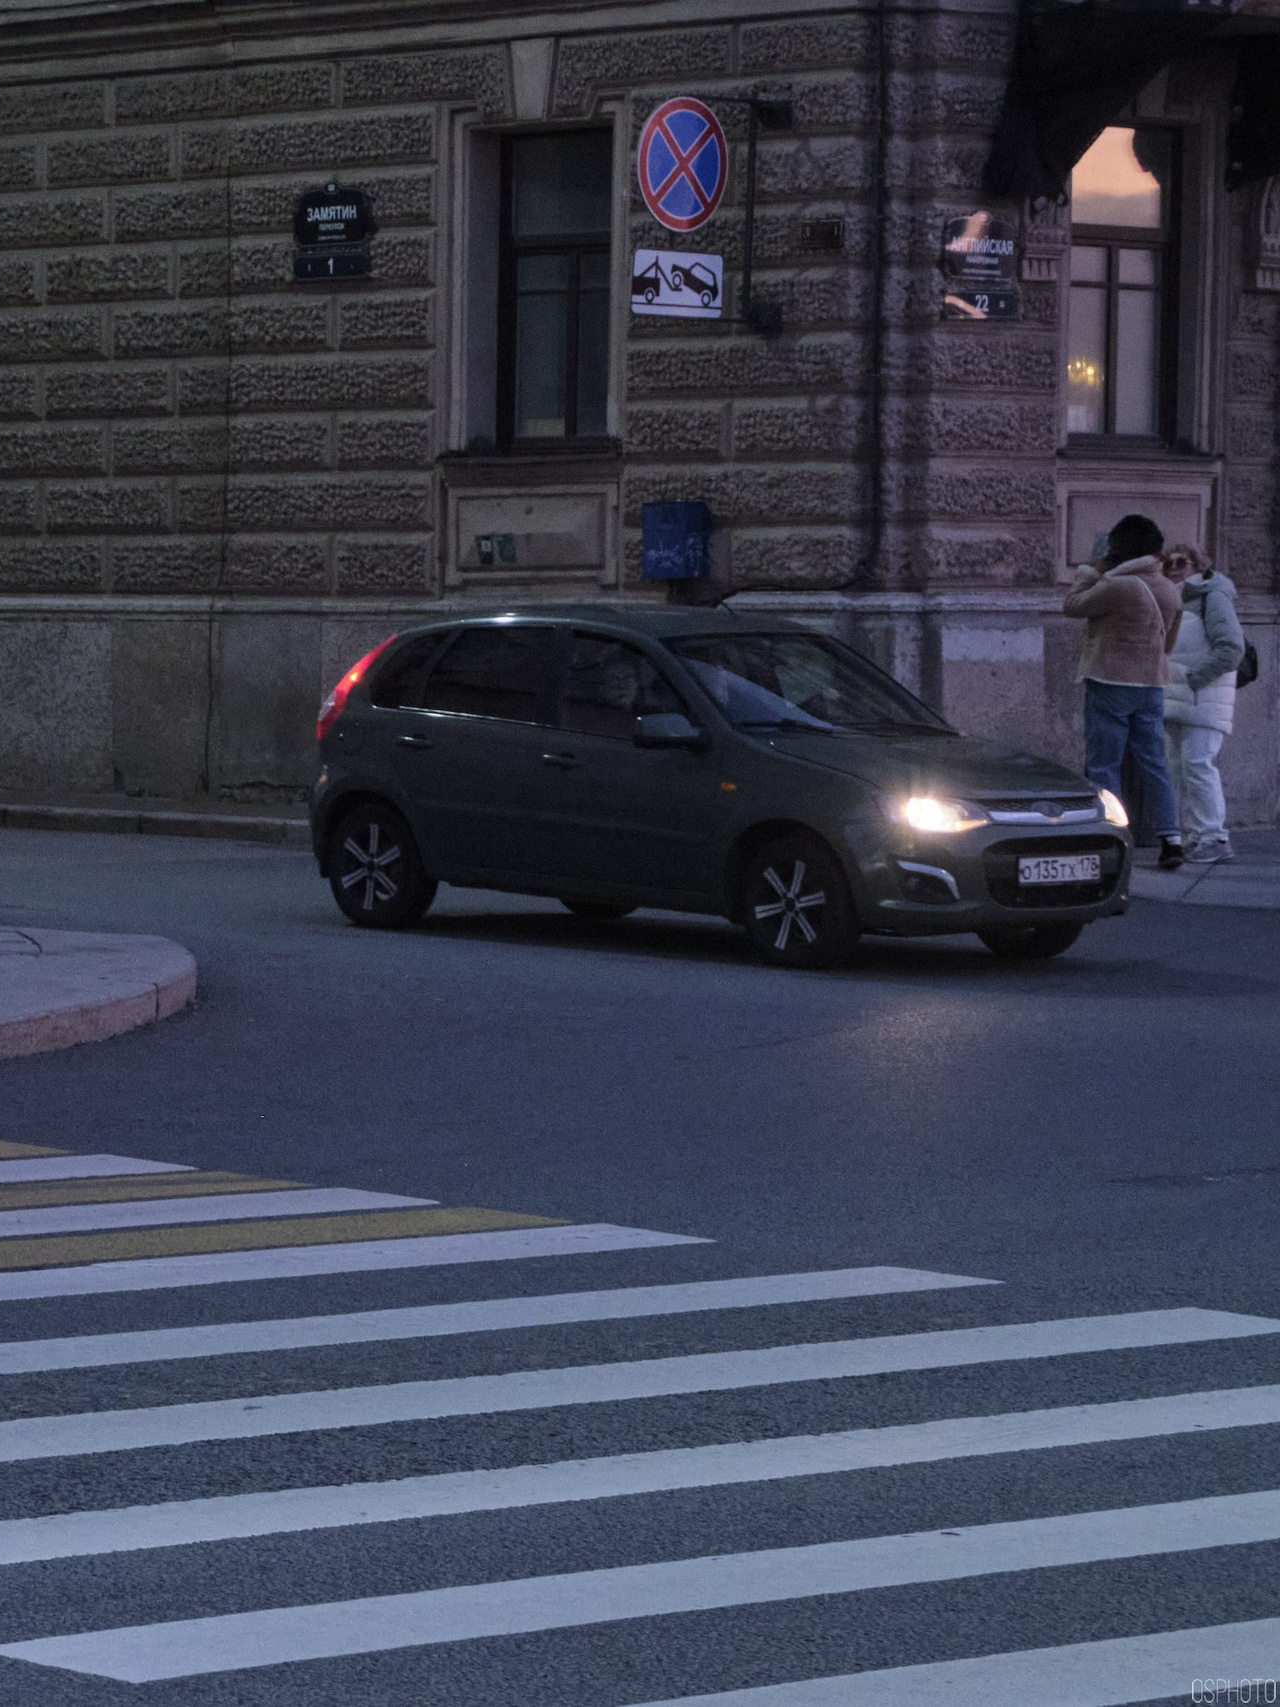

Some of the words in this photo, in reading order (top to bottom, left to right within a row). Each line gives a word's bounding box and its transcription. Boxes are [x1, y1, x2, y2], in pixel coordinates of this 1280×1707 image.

[306, 205, 357, 222] ЗАМЯТИН
[951, 236, 1014, 255] АНГЛИЙСКАЯ
[327, 257, 334, 274] 1
[975, 294, 990, 312] 22
